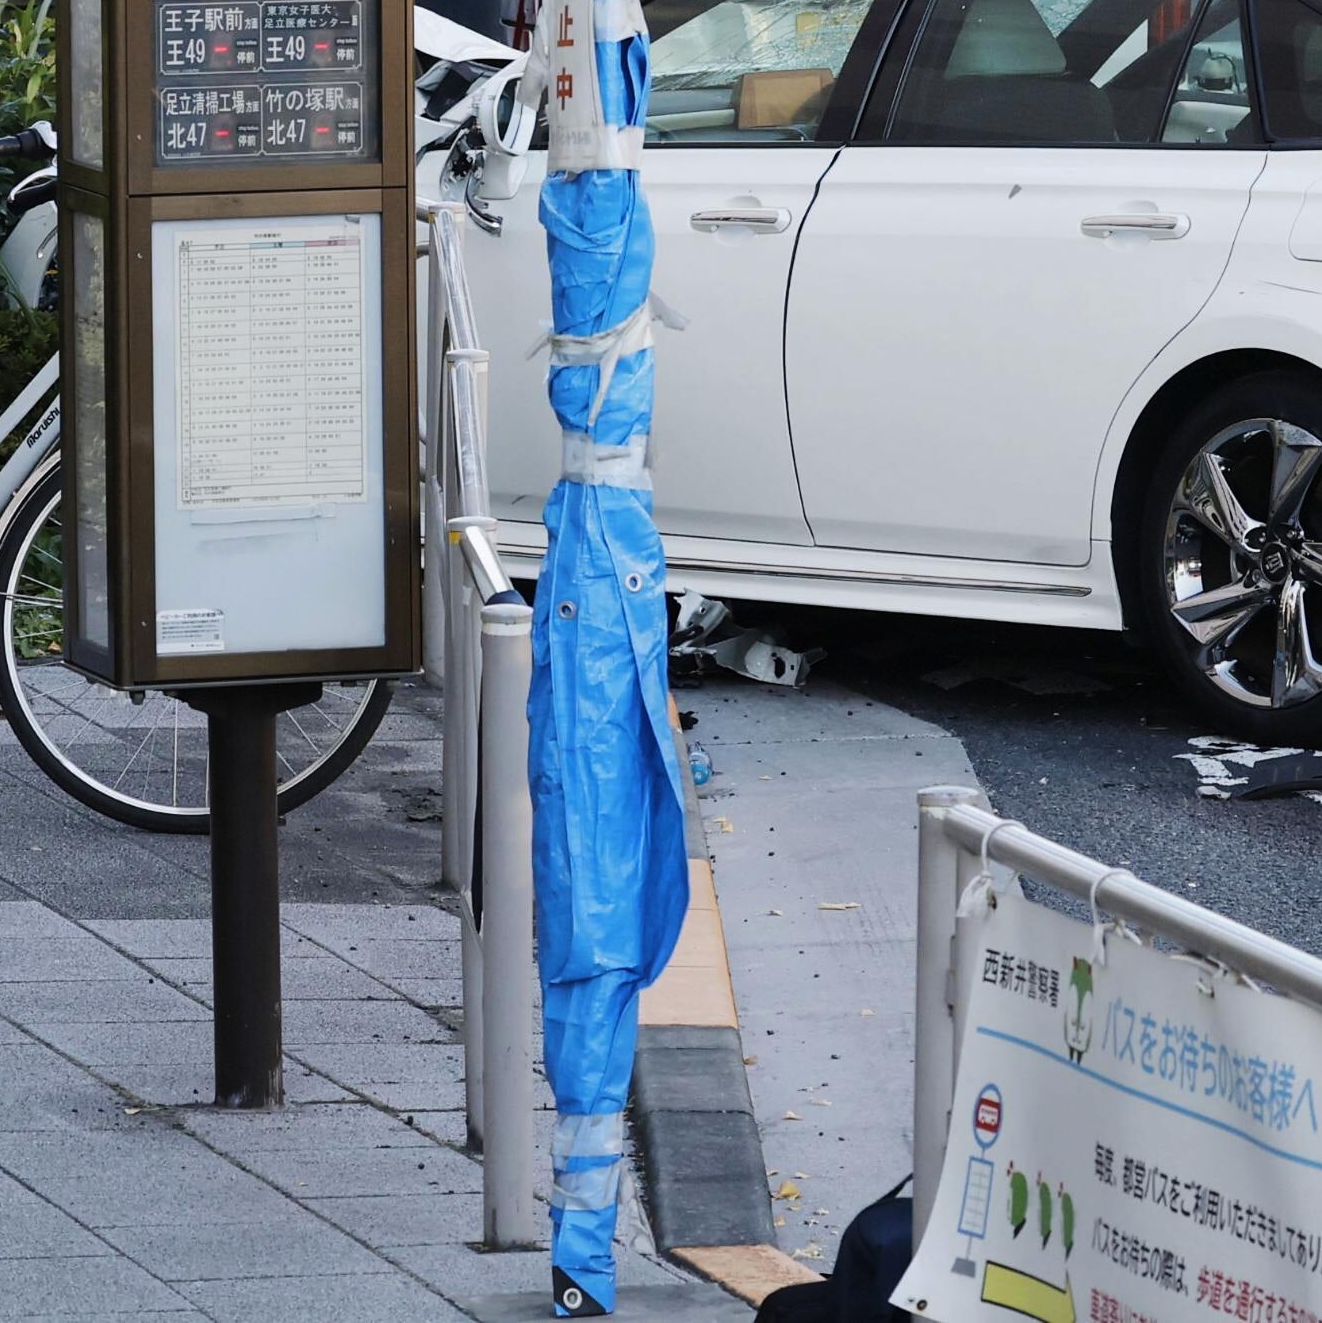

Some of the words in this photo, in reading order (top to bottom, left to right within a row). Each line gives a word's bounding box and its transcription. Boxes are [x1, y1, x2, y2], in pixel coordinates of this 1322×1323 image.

[164, 7, 259, 33] 王子駅前方面
[267, 4, 332, 17] 東京女子医大
[165, 38, 206, 67] 王49
[237, 50, 255, 64] 停前
[266, 35, 306, 63] 王49
[336, 48, 355, 61] 停前
[166, 90, 260, 117] 足立清掃工場方面
[266, 87, 359, 113] 竹の塚駅方面
[167, 122, 207, 150] 北47
[238, 134, 256, 148] 停前
[267, 119, 306, 146] 北47
[338, 130, 356, 144] 停前
[982, 947, 1059, 1008] 西新井警察署
[1103, 998, 1318, 1133] バスをお待ちのお客様へ
